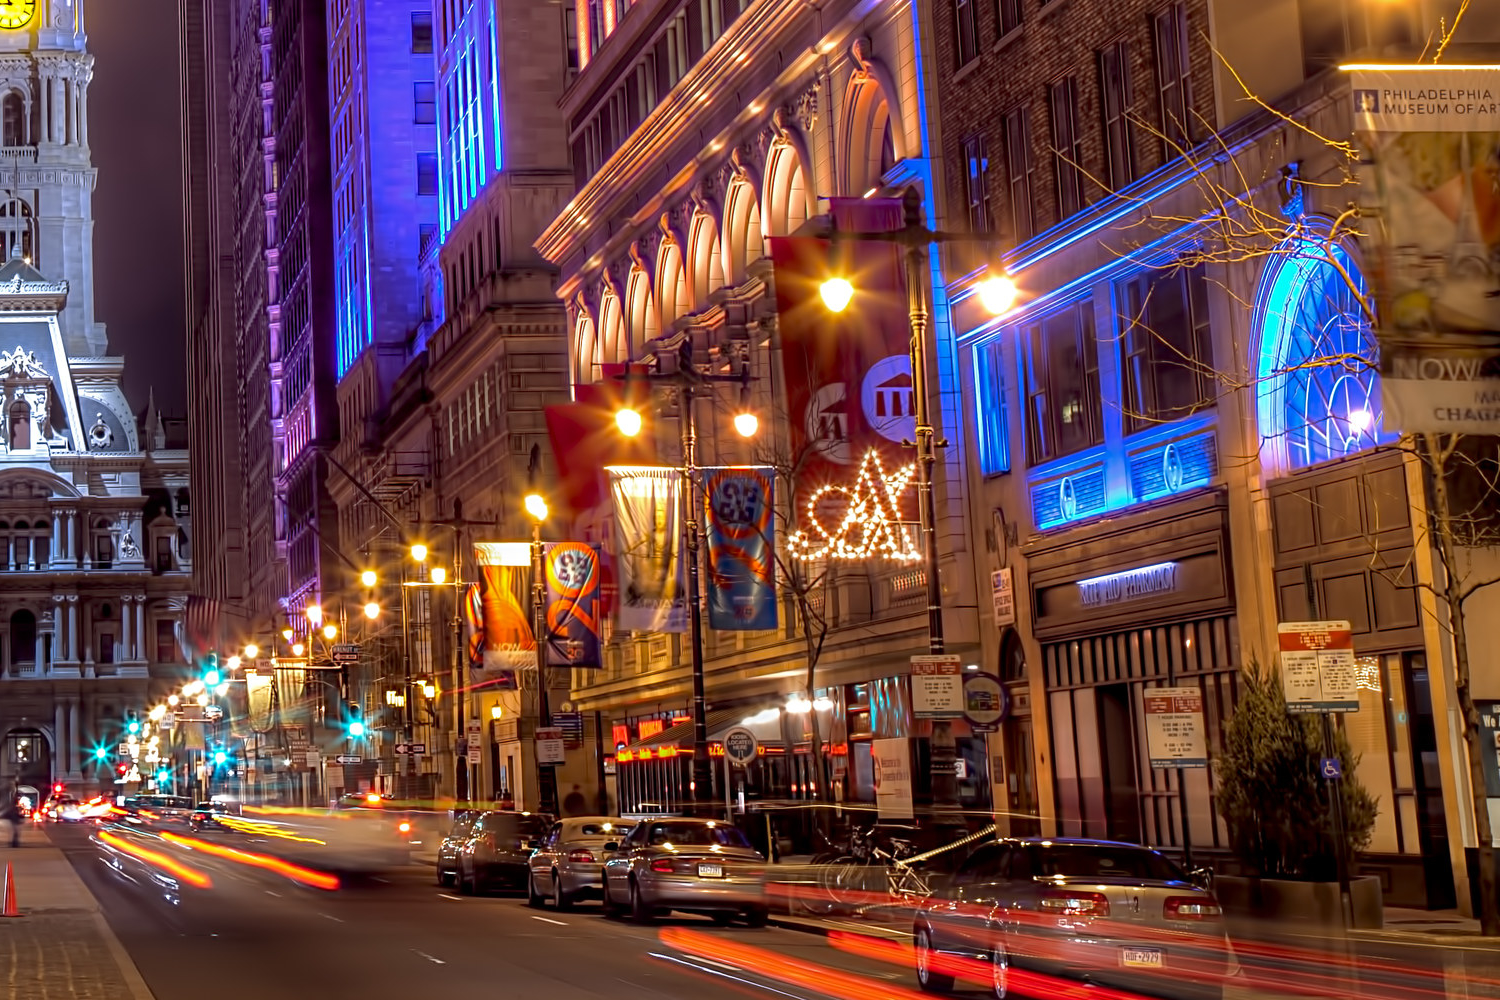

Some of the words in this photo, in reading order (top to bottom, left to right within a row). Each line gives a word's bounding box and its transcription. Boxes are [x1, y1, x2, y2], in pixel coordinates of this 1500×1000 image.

[1384, 89, 1492, 100] PHILADELPHIA
[1384, 103, 1449, 114] MUSEUM
[1455, 103, 1474, 114] OF
[1392, 357, 1480, 381] NOW
[1125, 565, 1176, 598] PHARMACY
[1483, 714, 1497, 728] We
